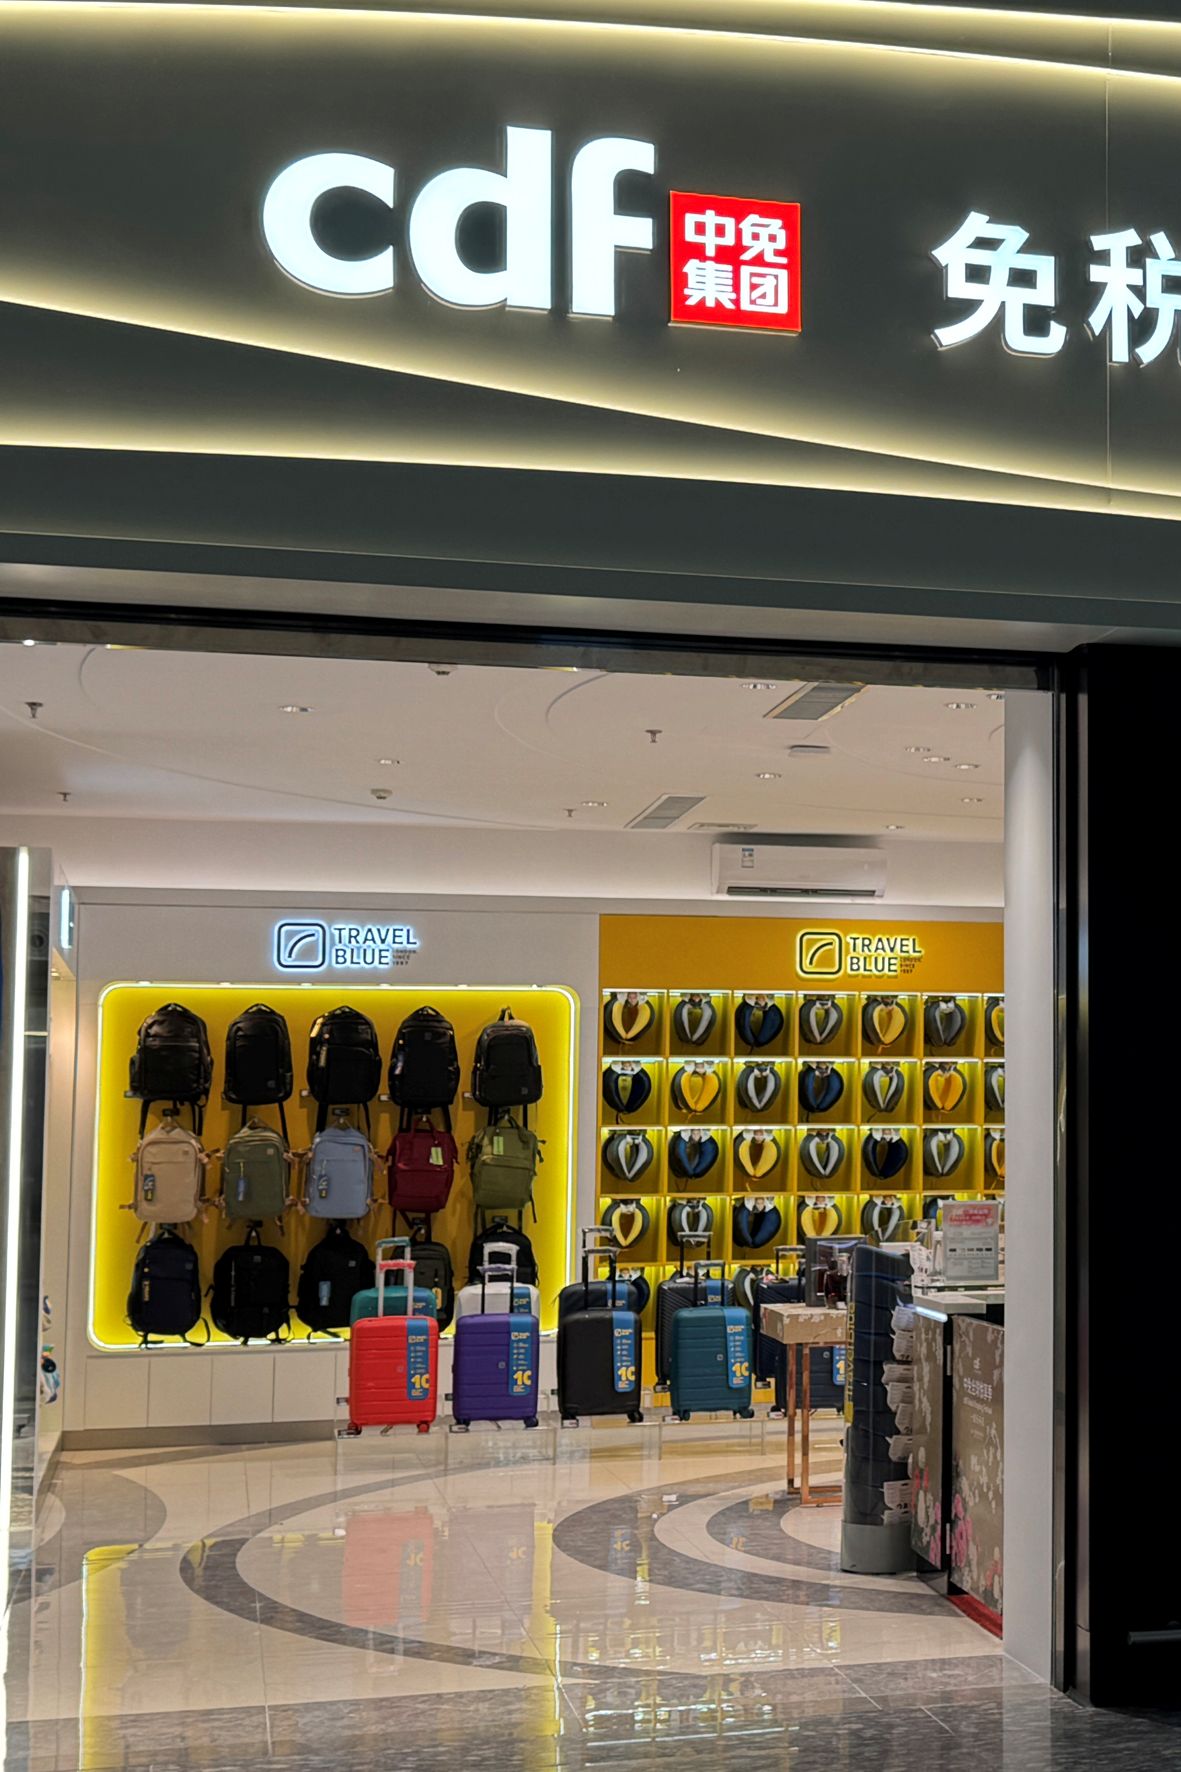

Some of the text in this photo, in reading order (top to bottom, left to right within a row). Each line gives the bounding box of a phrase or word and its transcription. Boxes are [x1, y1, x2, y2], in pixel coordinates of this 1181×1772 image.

[262, 125, 656, 318] cdf
[683, 209, 788, 264] 中免
[682, 258, 789, 315] 集团
[333, 927, 418, 945] TRAVEL
[849, 936, 922, 954] TRAVEL
[335, 948, 390, 965] BLUE
[850, 956, 898, 973] BLUE
